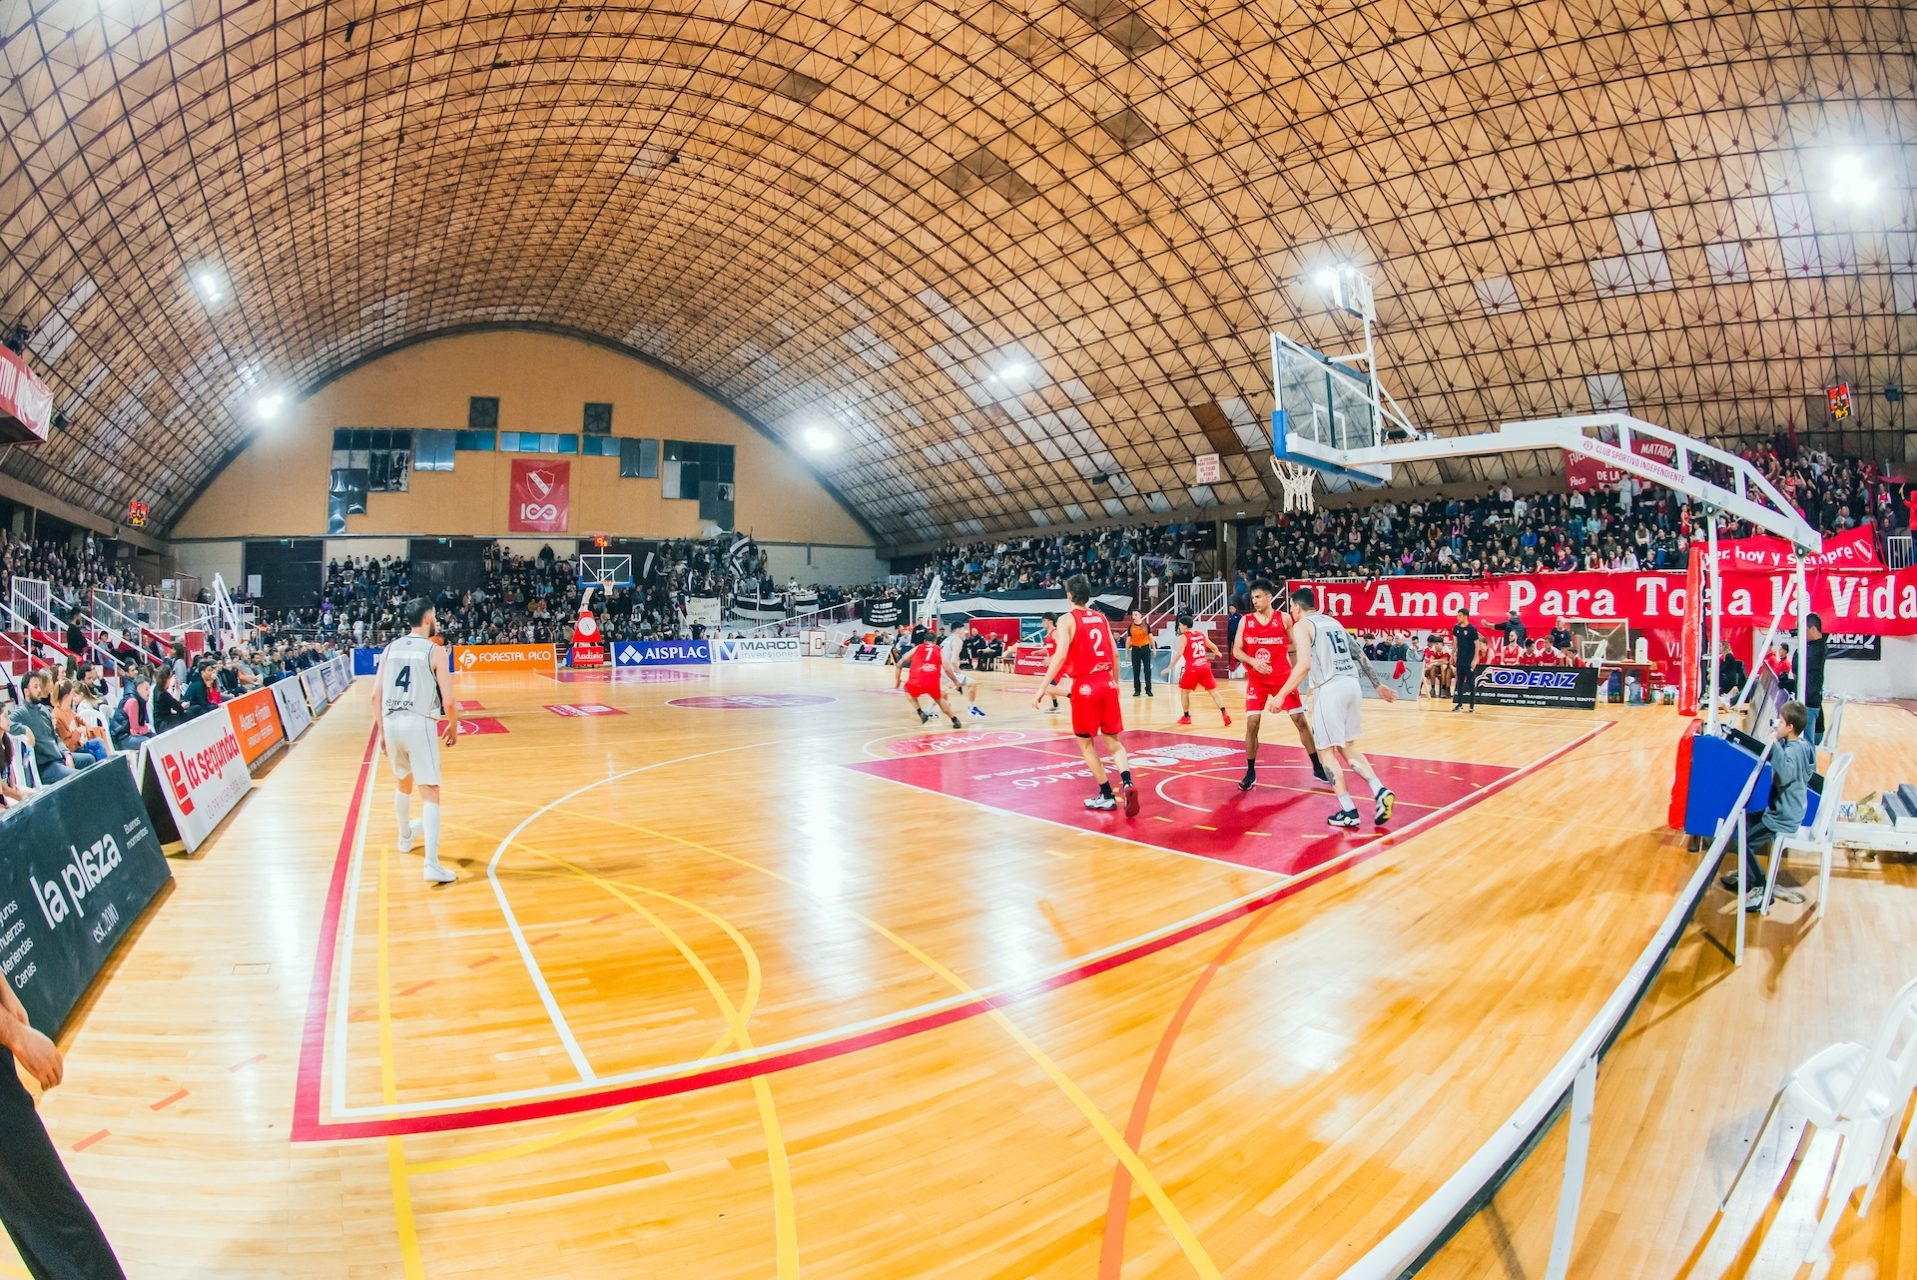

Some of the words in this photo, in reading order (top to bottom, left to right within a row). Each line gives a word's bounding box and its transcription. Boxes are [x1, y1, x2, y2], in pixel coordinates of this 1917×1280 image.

[1595, 444, 1611, 456] CLUB
[1611, 450, 1640, 467] SPORTIVO
[1640, 461, 1686, 484] INDEPENDIENTE
[1596, 470, 1608, 480] DE
[1610, 470, 1620, 481] LA
[1735, 546, 1765, 565] hoy
[1771, 553, 1781, 566] y
[1366, 584, 1489, 617] Amor
[1506, 580, 1616, 616] Para
[1826, 575, 1917, 620] Vida
[1248, 620, 1255, 628] 12
[645, 646, 708, 660] AISPLAC
[740, 641, 798, 650] MARCO
[1090, 628, 1104, 656] 2
[1191, 641, 1206, 658] 25
[1326, 630, 1349, 654] 15
[479, 651, 526, 662] FORESTAL
[528, 650, 551, 661] PICO
[925, 648, 934, 661] 7
[395, 666, 411, 692] 4
[180, 750, 201, 790] la
[196, 726, 241, 780] segunda
[124, 816, 141, 835] Buenos
[126, 826, 149, 850] momentos
[29, 875, 70, 930] la
[100, 902, 120, 932] 2010
[93, 918, 108, 944] est.
[14, 961, 37, 989] Cenas
